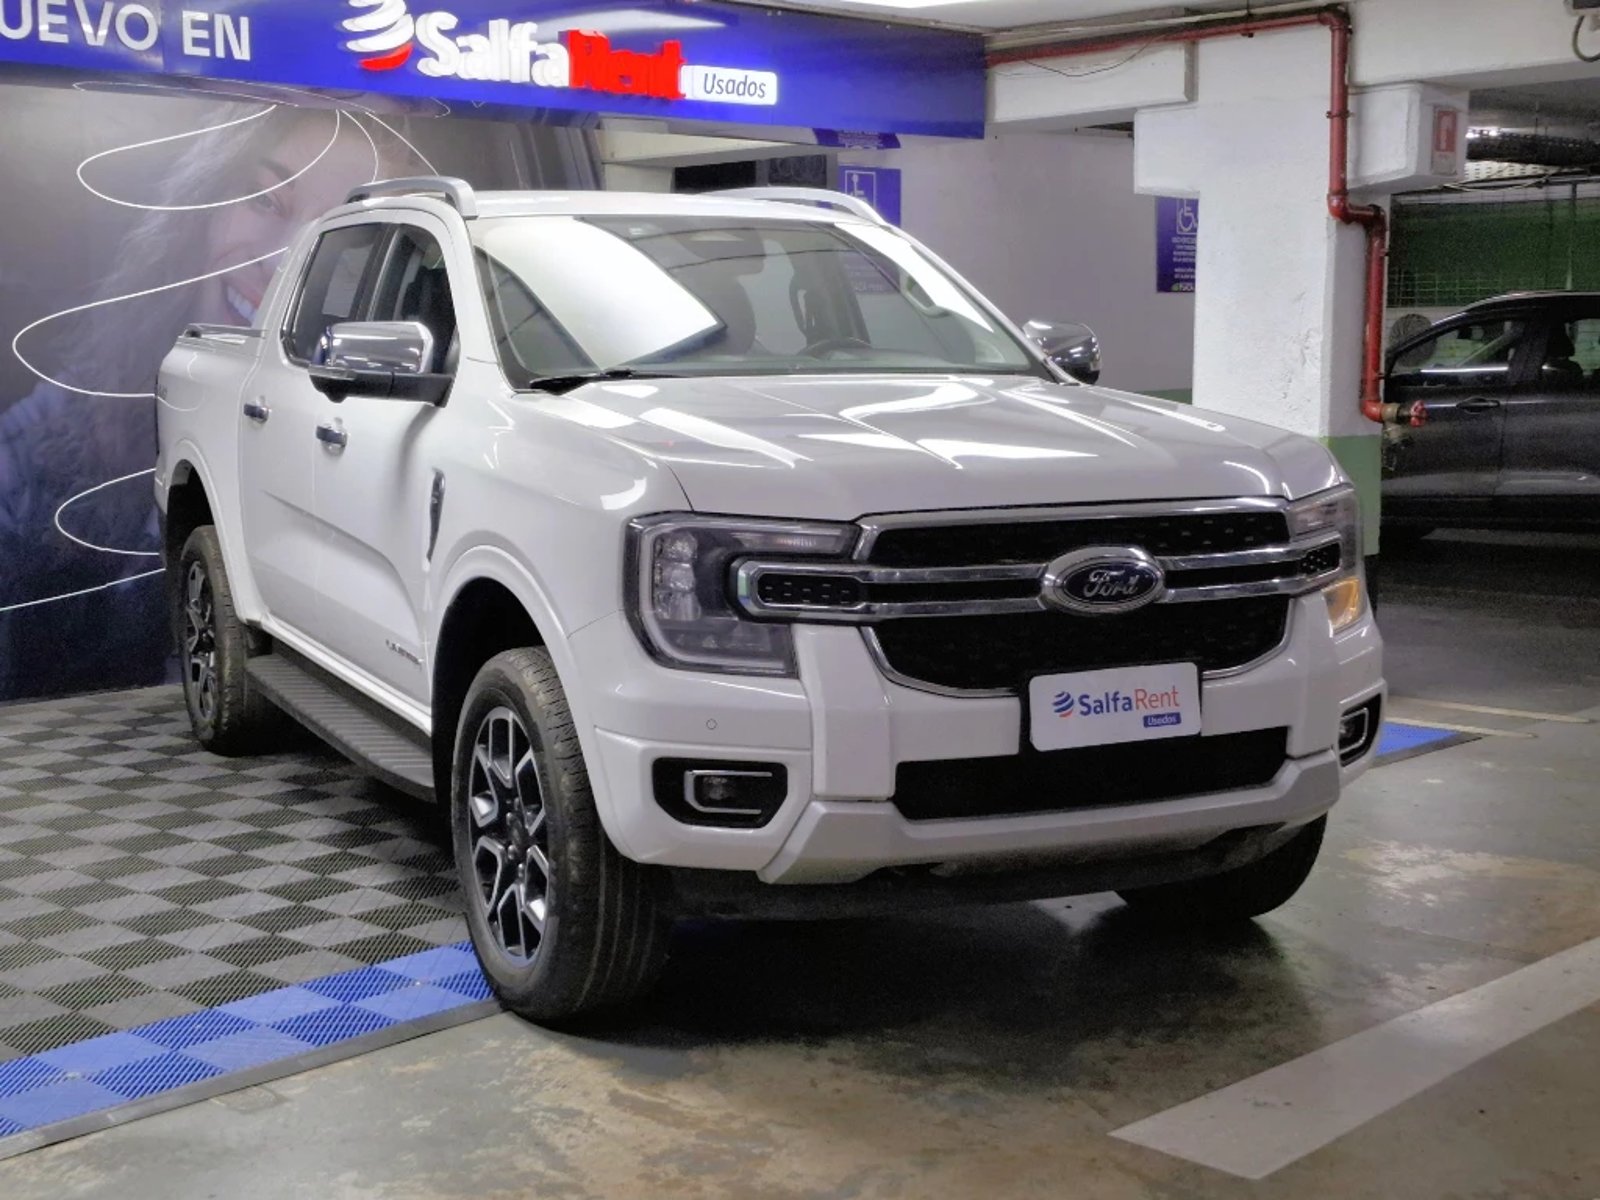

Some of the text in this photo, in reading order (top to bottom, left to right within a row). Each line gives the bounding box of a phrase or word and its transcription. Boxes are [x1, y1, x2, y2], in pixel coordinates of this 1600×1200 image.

[182, 10, 251, 61] EN
[703, 73, 767, 98] Usados
[1083, 569, 1140, 598] Ford
[1078, 685, 1180, 716] SalfaRent
[1147, 715, 1178, 726] Usados
